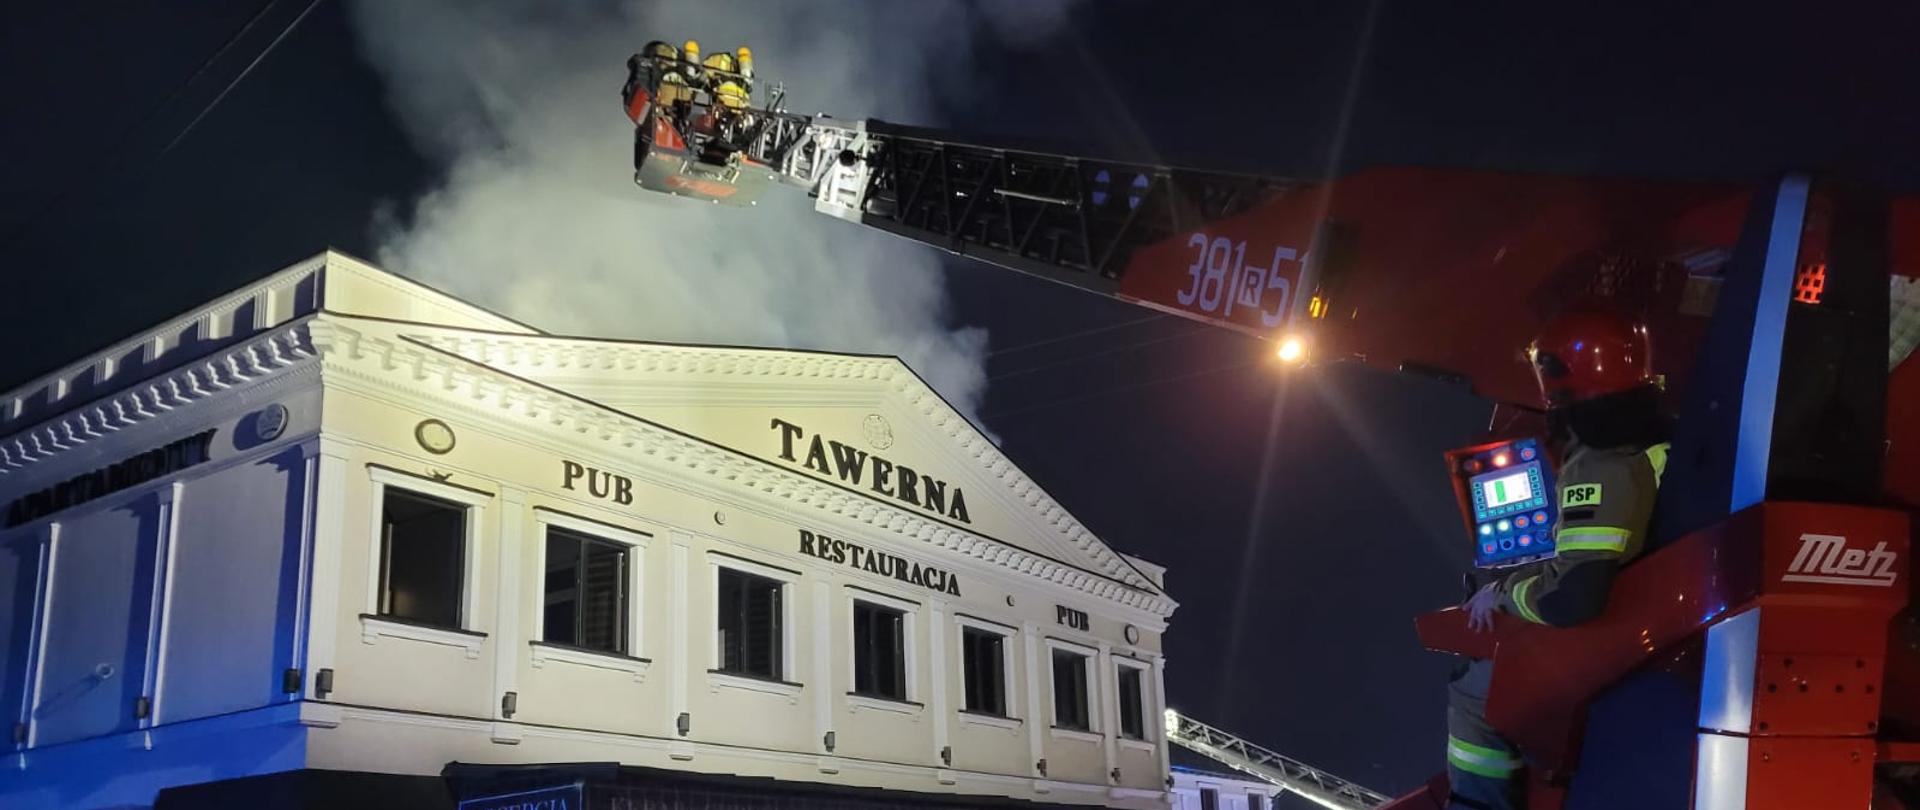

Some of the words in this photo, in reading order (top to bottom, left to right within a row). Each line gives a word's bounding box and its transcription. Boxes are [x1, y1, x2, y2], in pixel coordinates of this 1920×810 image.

[561, 460, 633, 505] PUB
[771, 418, 971, 524] TAWERNA
[1567, 487, 1595, 503] PSP
[799, 529, 961, 597] RESTAURACJA
[1781, 533, 1897, 587] Metz
[1056, 604, 1089, 632] PUB
